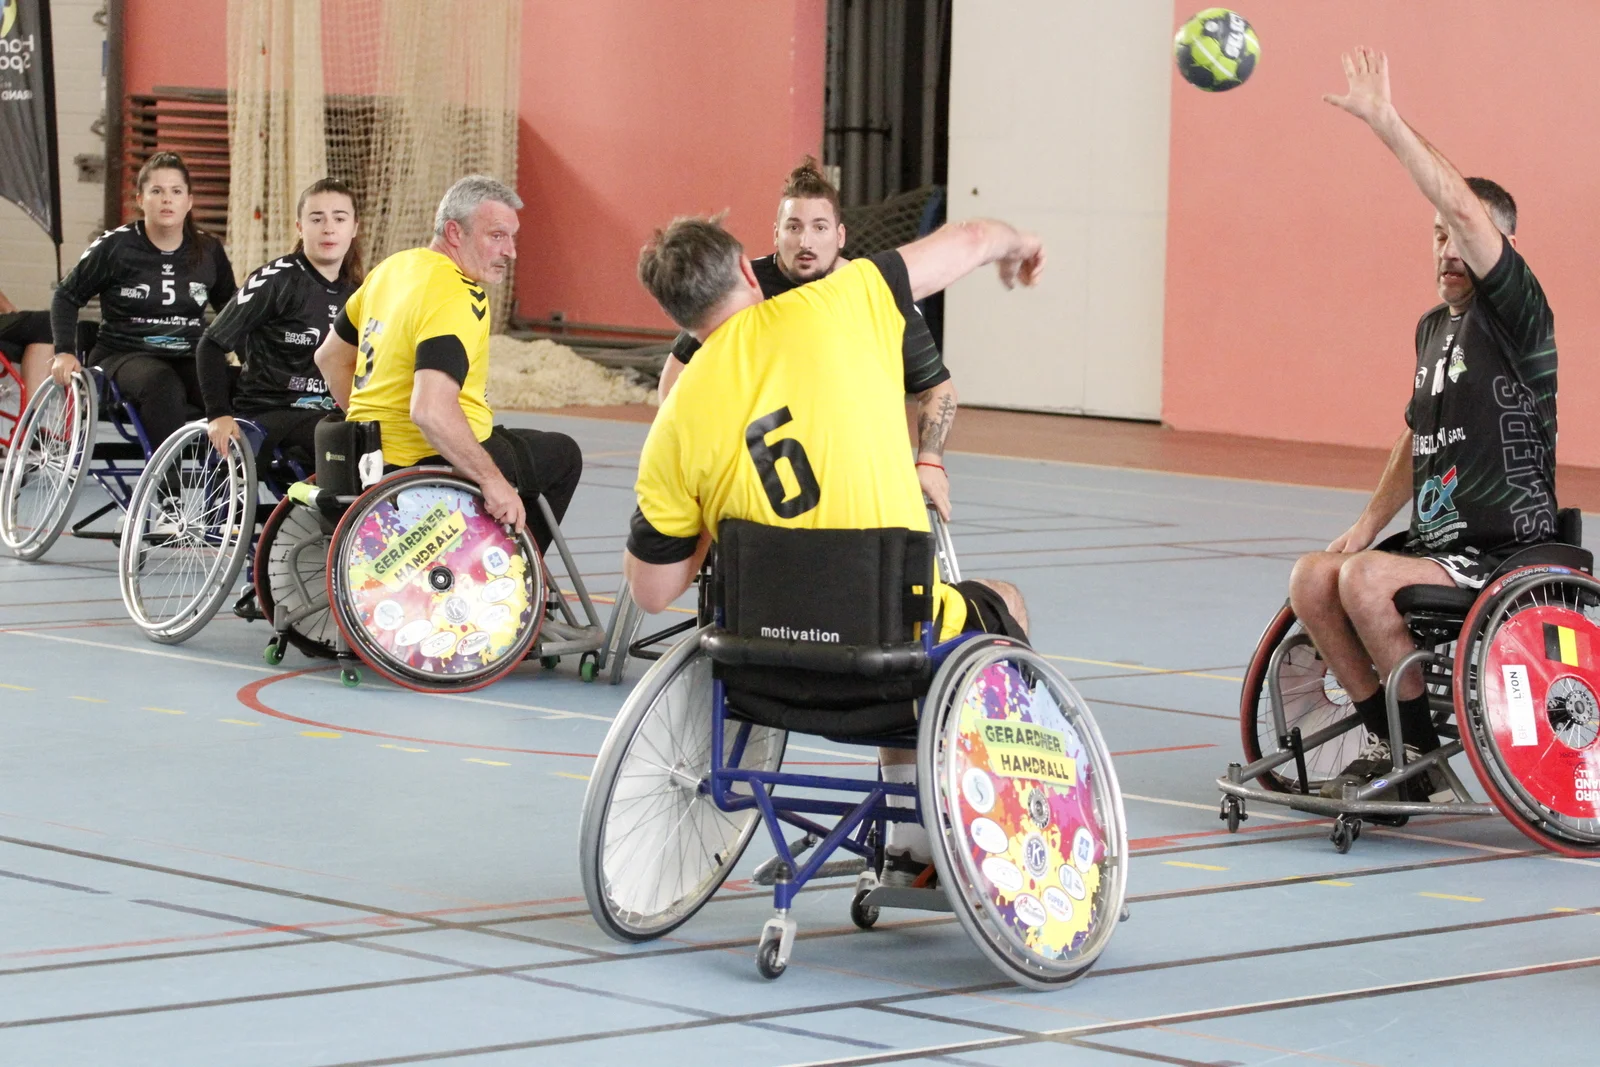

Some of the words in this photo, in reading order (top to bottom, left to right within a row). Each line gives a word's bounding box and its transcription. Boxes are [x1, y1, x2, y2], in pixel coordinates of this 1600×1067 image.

[162, 280, 176, 306] 5
[745, 405, 820, 518] 6
[374, 508, 447, 575] GERARDMER
[394, 524, 459, 582] HANDBALL
[761, 626, 840, 643] motivation
[1509, 671, 1521, 699] LYON
[985, 725, 1062, 753] GERARDMER
[1001, 753, 1069, 780] HANDBALL
[1575, 790, 1600, 802] URO
